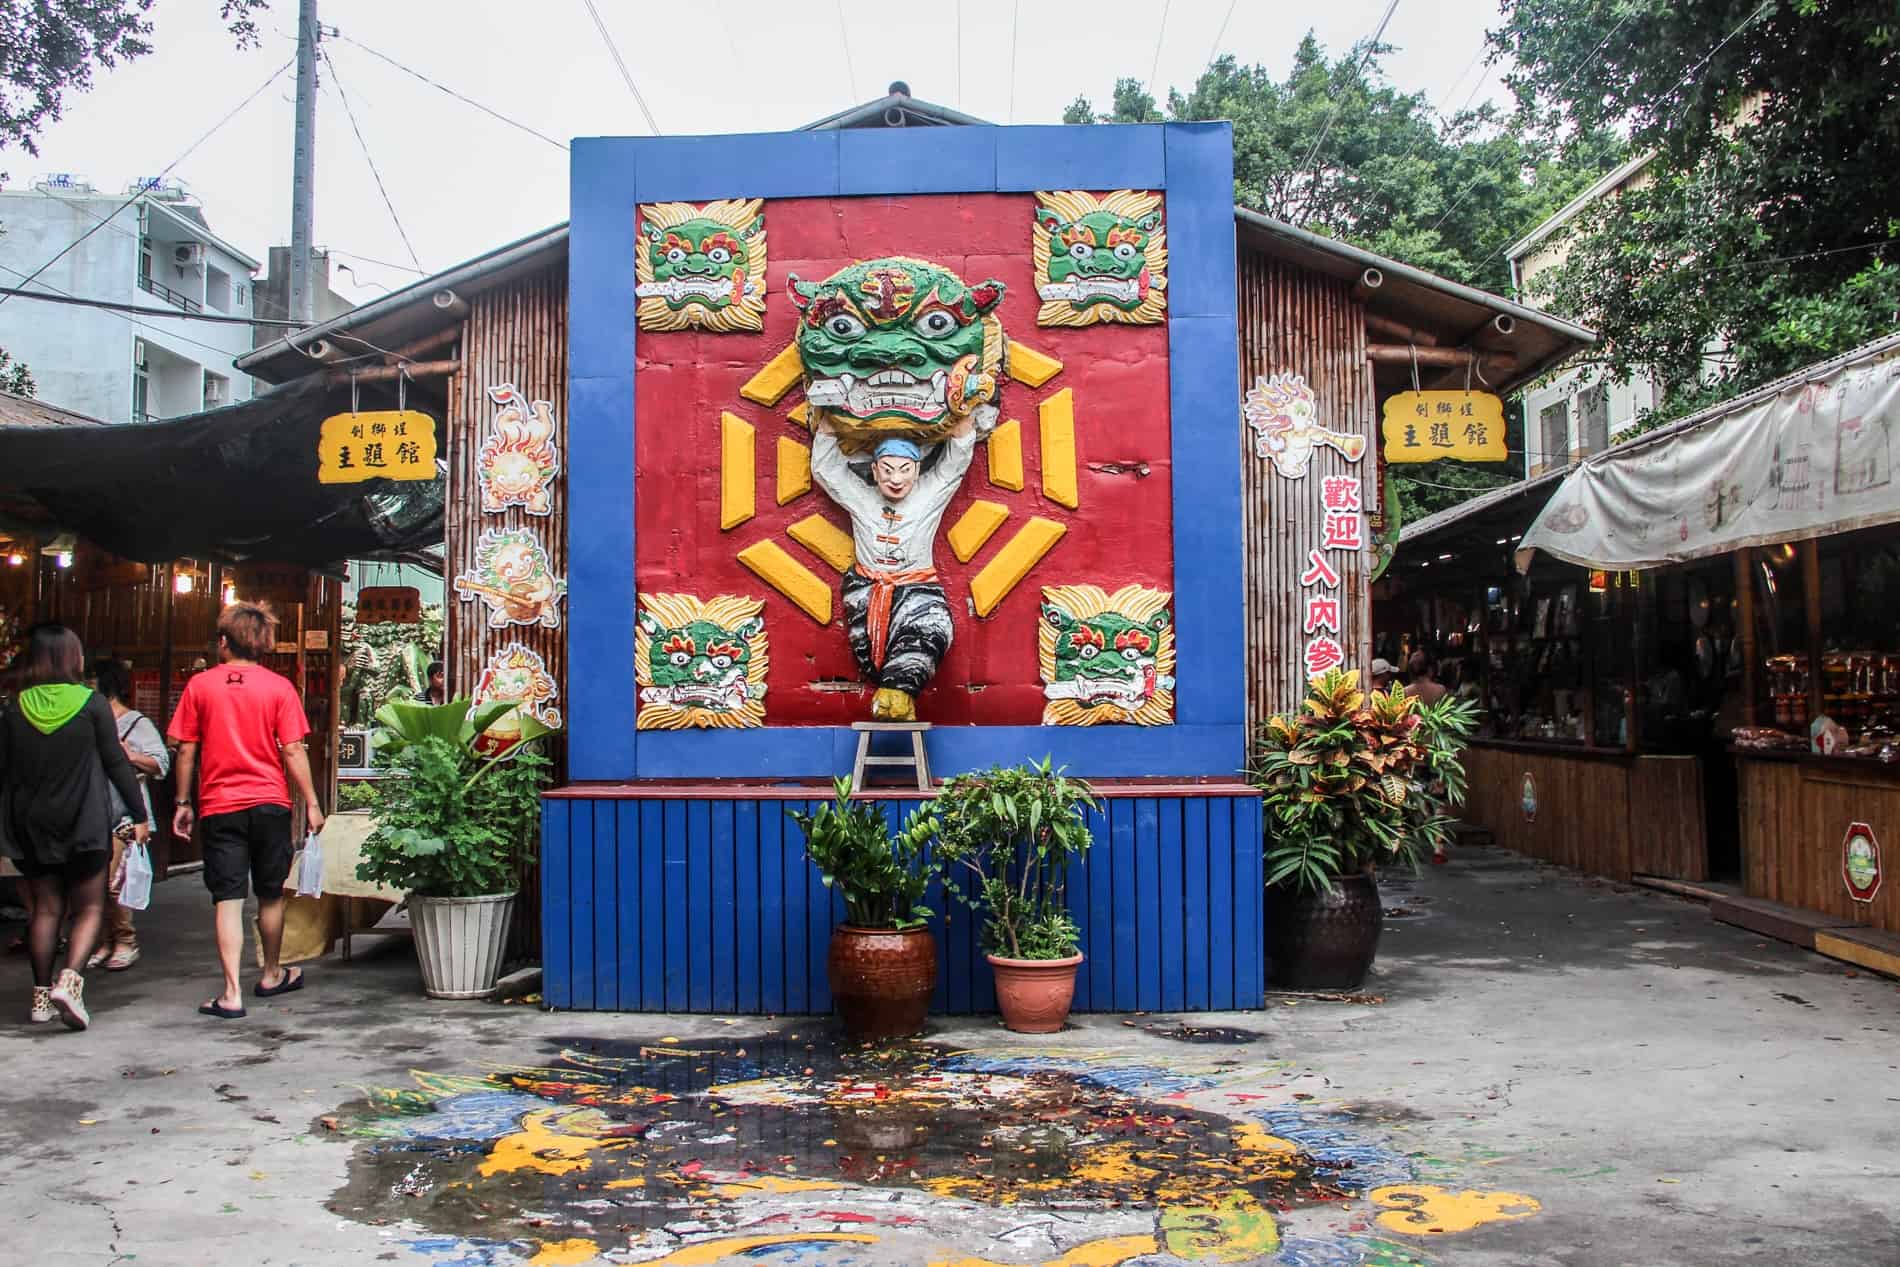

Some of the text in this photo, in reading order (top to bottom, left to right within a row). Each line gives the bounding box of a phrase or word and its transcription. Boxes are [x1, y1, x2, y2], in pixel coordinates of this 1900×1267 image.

[1403, 422, 1488, 448] 主題館
[338, 441, 420, 468] 主題館
